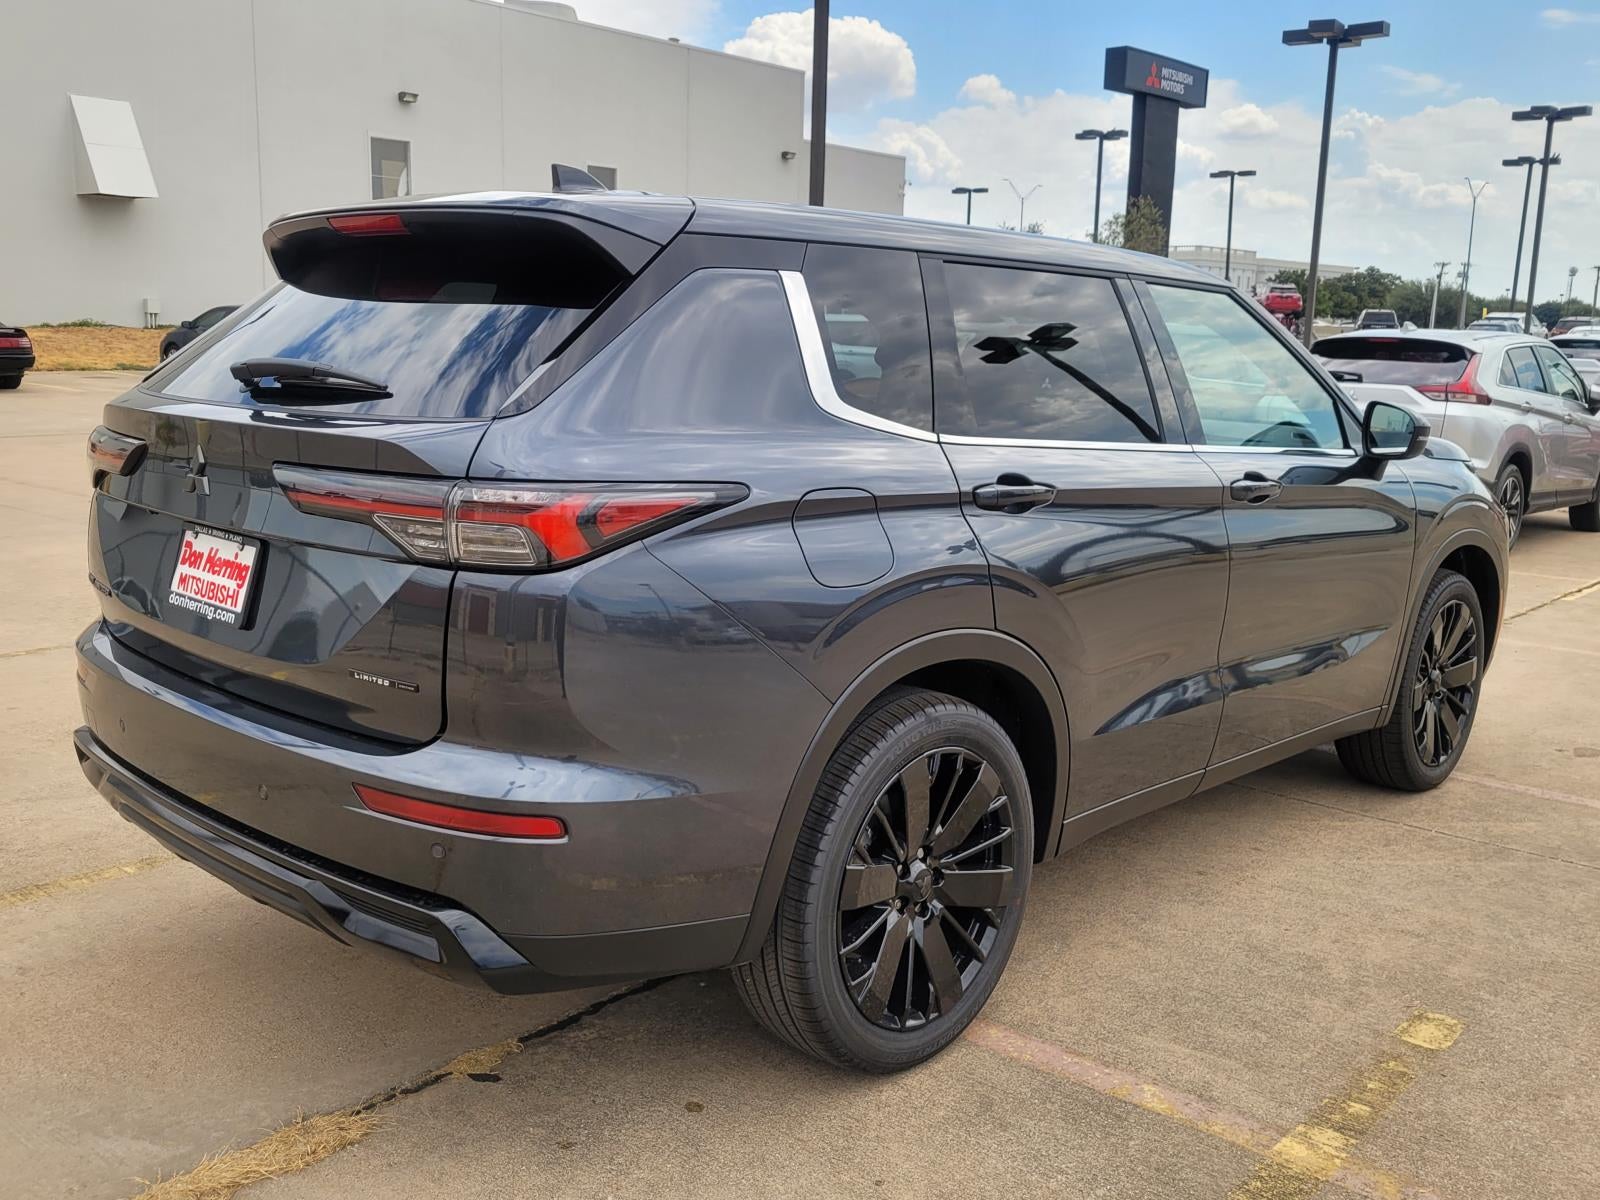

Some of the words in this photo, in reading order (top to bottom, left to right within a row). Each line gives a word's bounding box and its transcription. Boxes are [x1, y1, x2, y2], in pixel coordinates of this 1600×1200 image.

[1161, 67, 1194, 86] MITSUBISHI
[1160, 79, 1185, 95] MOTORS
[194, 525, 208, 534] DALLAS
[229, 533, 243, 543] PLANO
[179, 539, 204, 571] Don
[202, 546, 251, 590] Herring
[177, 571, 240, 609] MITSUBISHI
[168, 592, 235, 624] donherring.com
[354, 671, 390, 686] LIMITED
